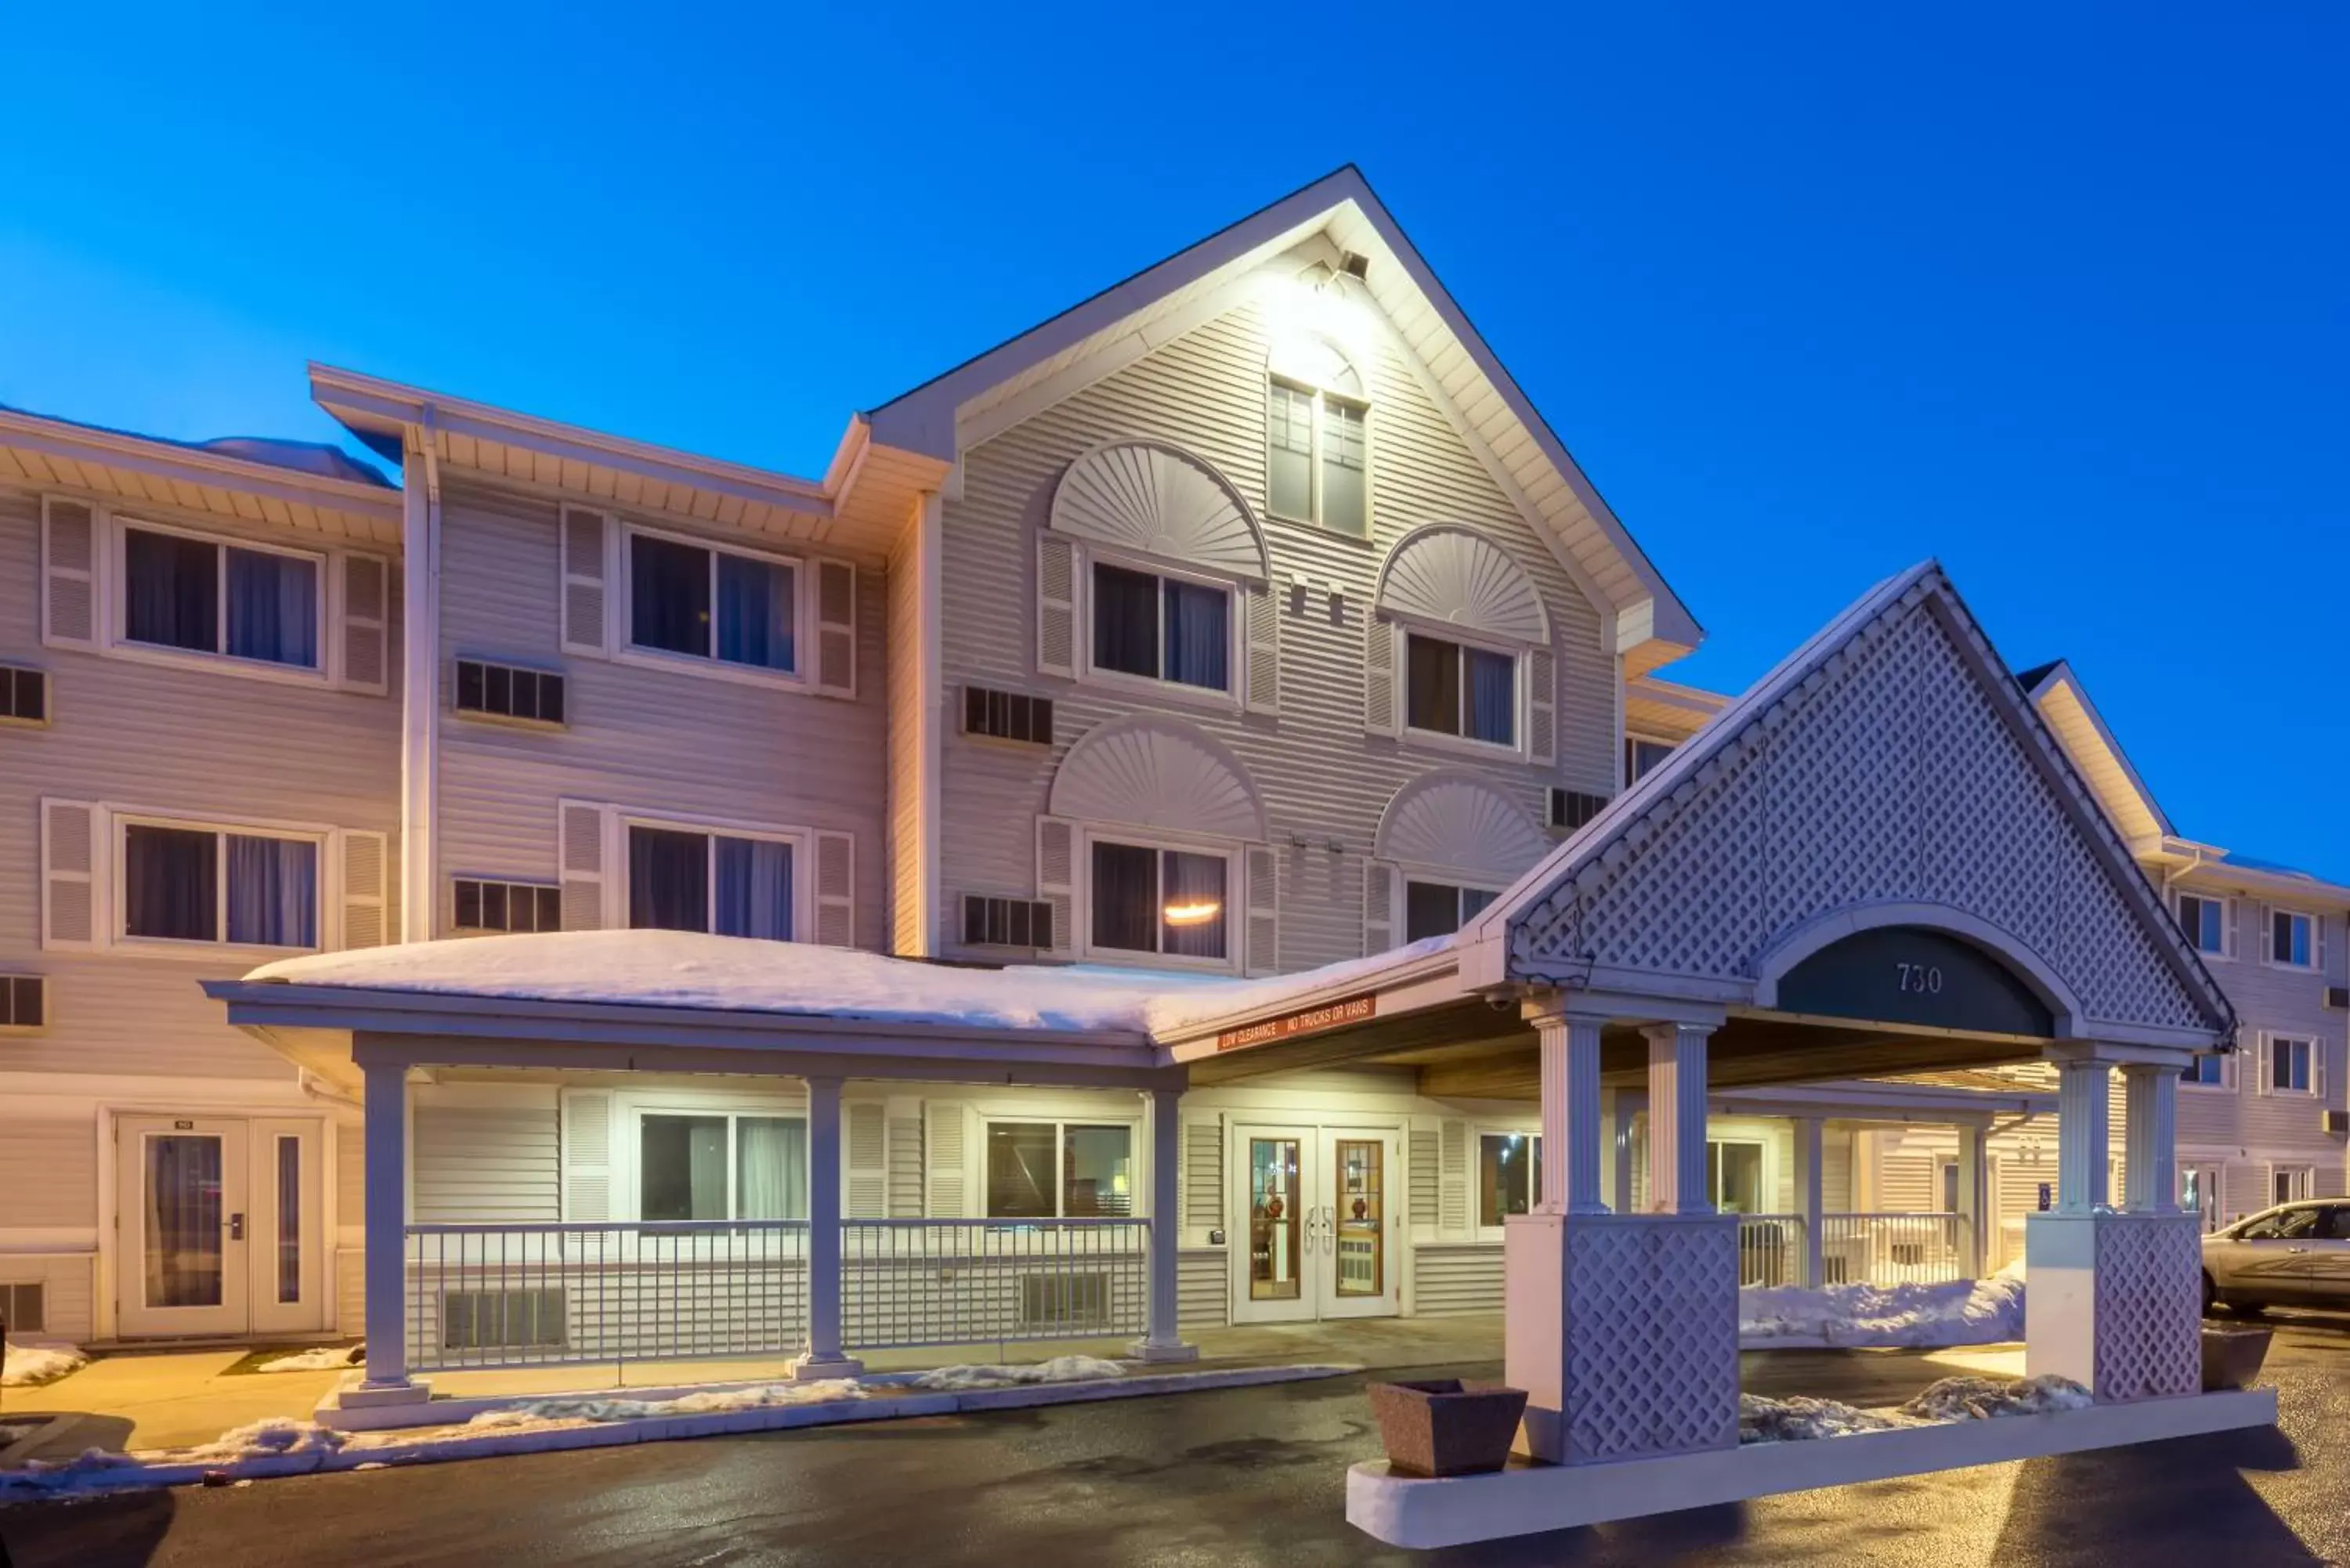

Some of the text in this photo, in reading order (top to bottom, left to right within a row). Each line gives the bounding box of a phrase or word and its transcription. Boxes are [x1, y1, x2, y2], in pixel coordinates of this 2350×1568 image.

[1896, 963, 1943, 994] 730
[1222, 999, 1368, 1047] LOW CLEARANCE NO TRUCKS OR VANS
